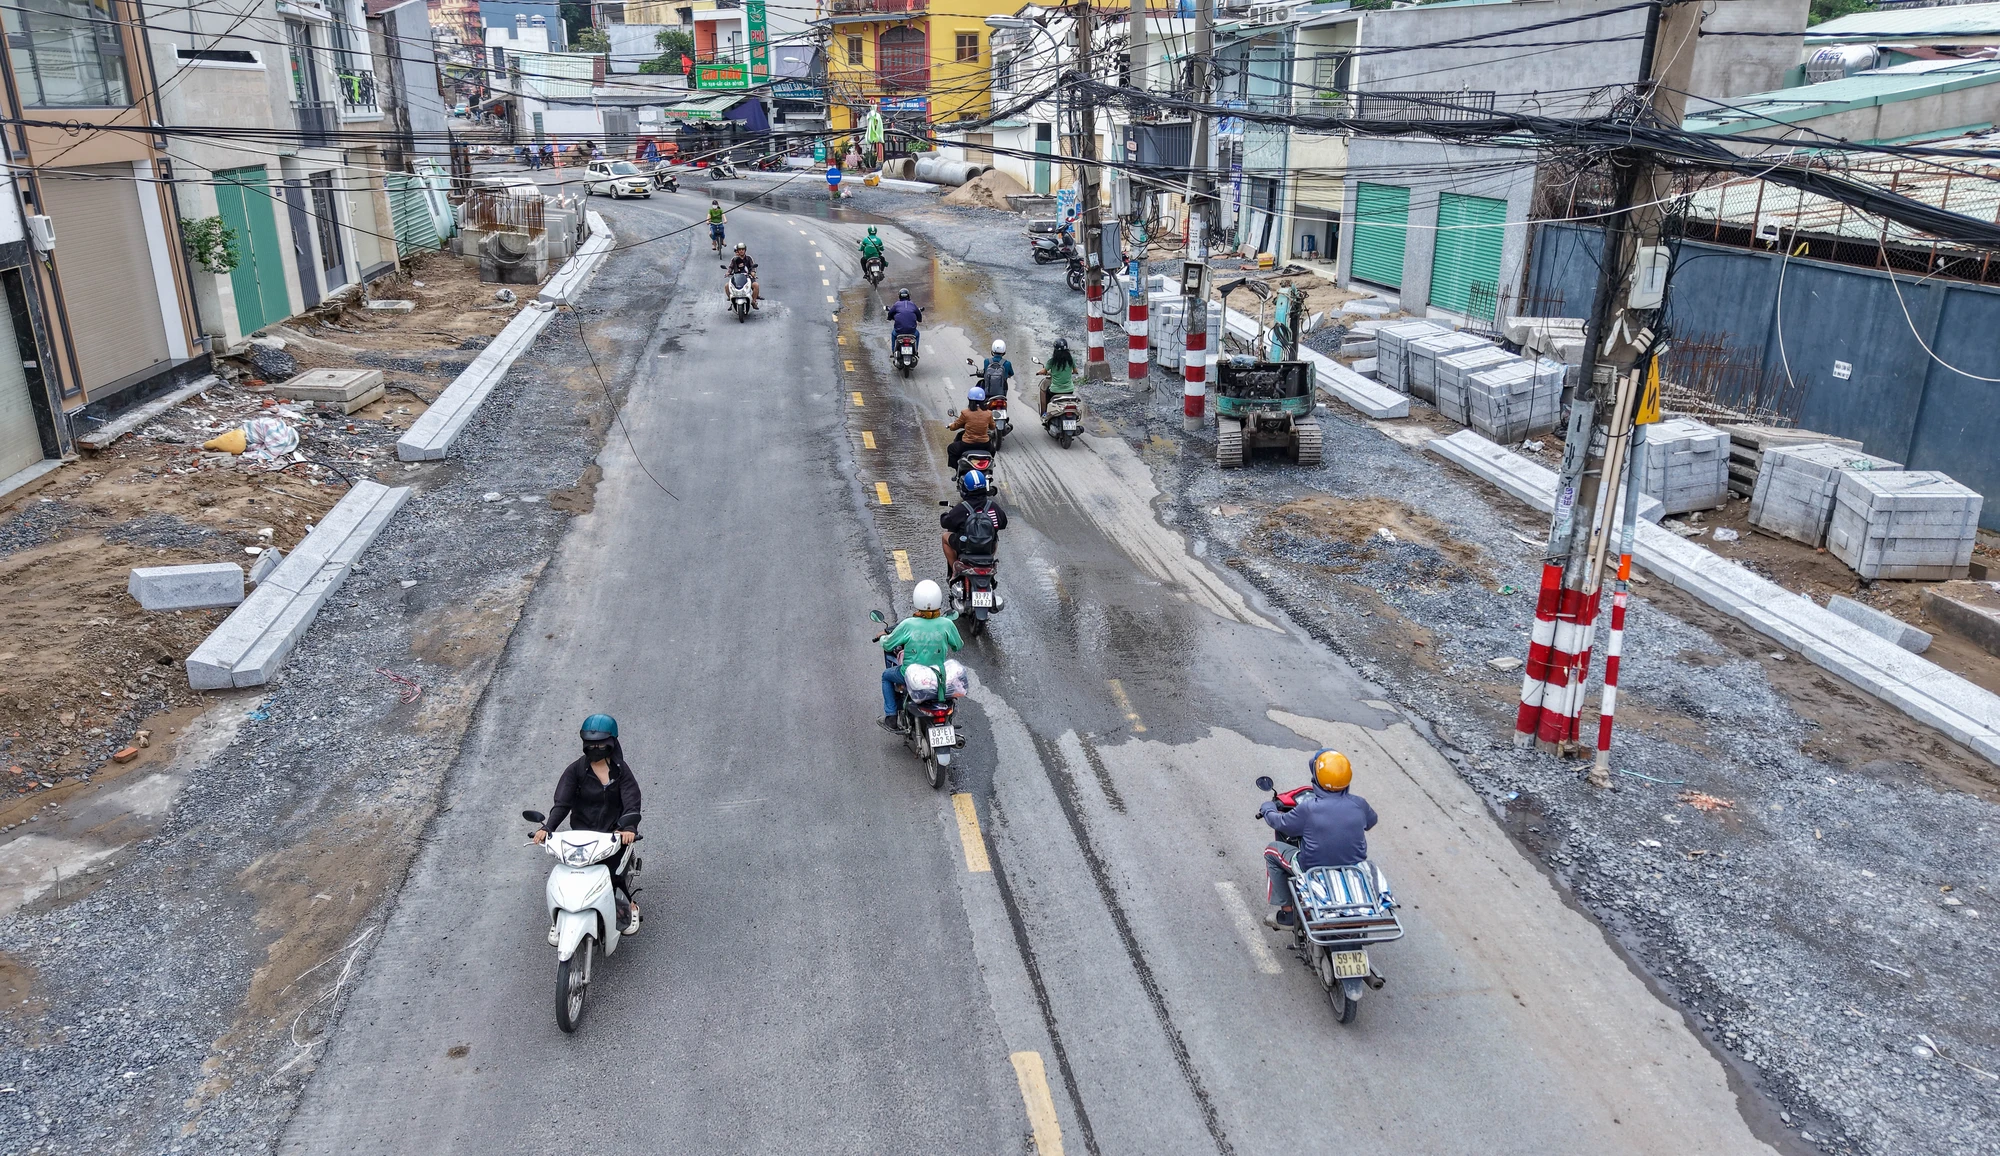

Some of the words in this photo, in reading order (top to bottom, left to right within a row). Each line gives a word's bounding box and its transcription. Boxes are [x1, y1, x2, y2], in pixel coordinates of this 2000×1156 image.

[750, 25, 766, 42] PHỞ
[1337, 952, 1363, 964] 59-N2
[1336, 964, 1366, 976] 011.81
